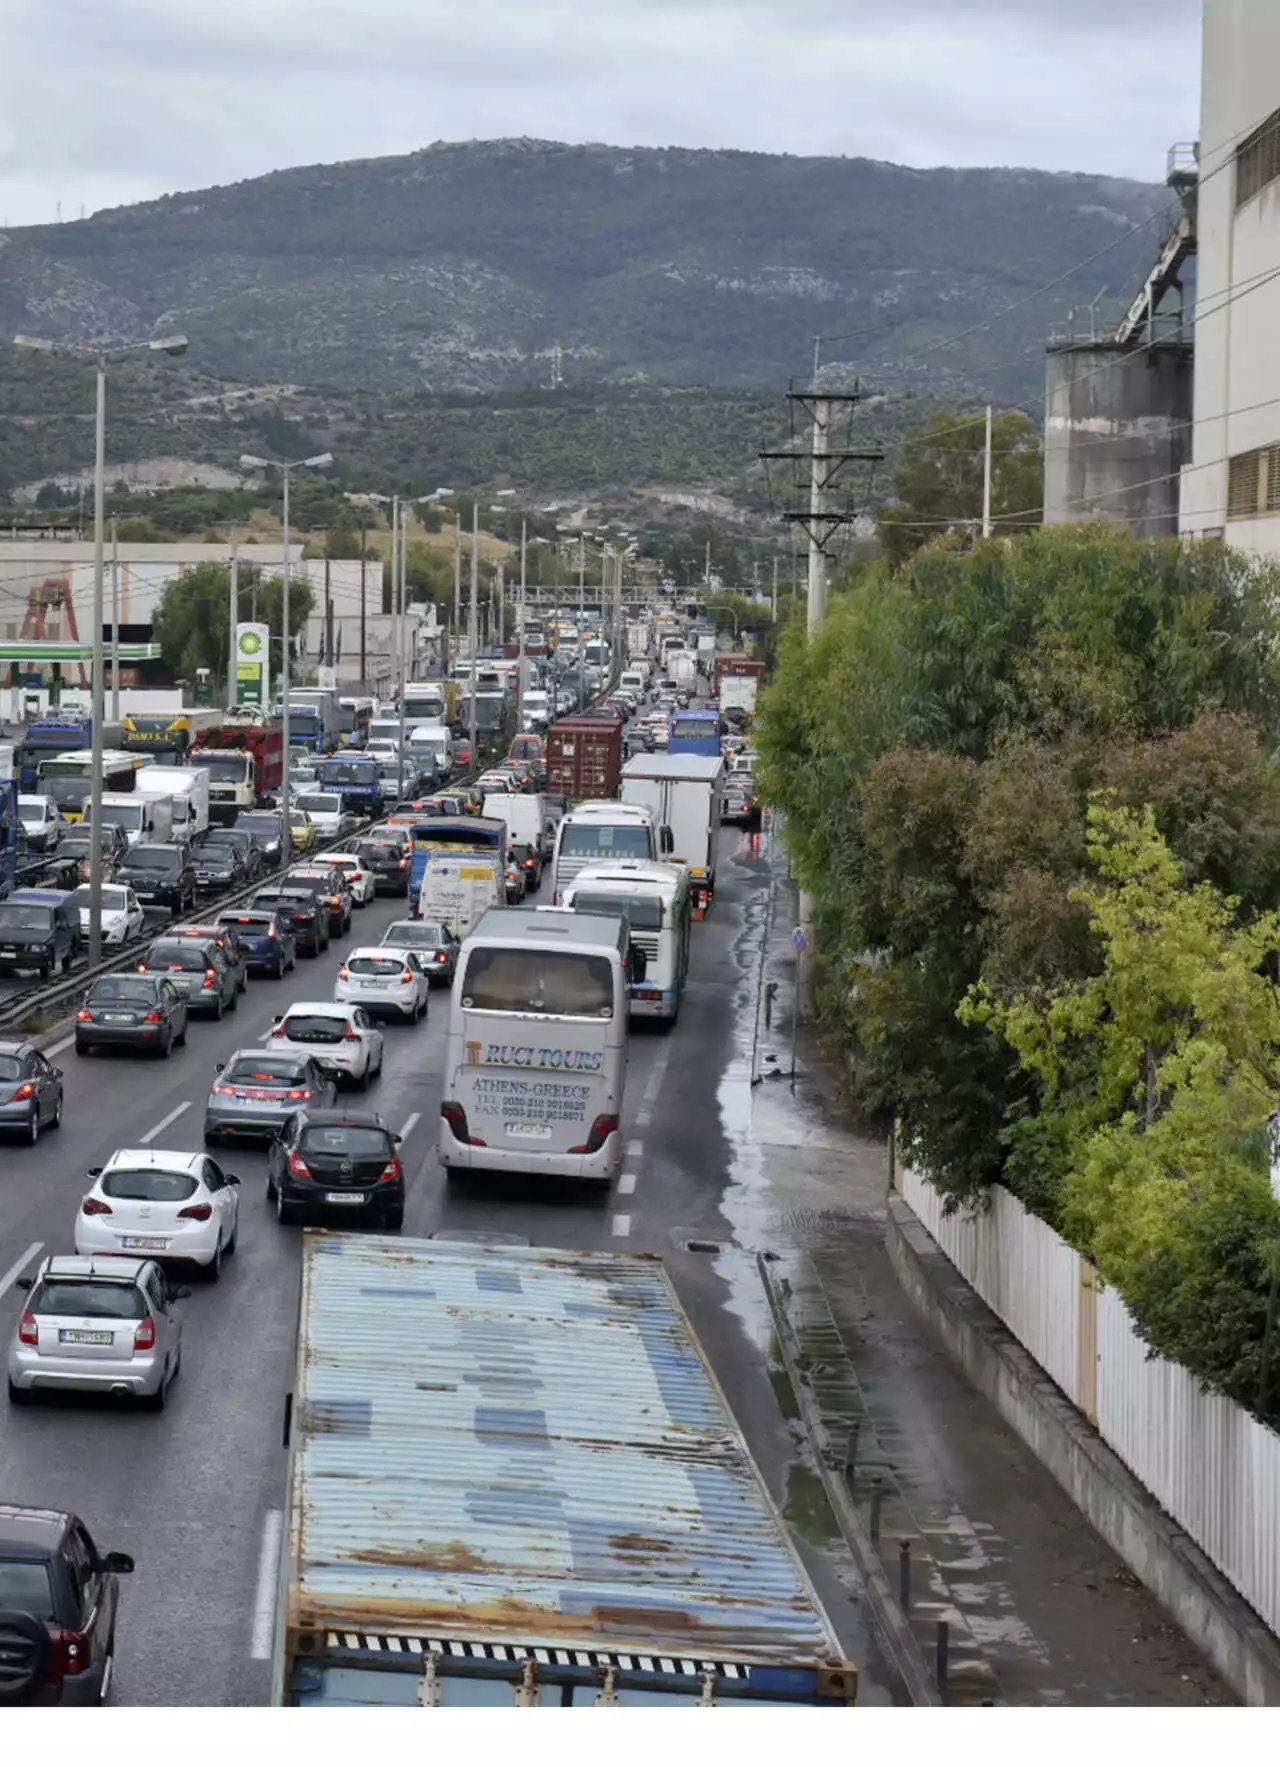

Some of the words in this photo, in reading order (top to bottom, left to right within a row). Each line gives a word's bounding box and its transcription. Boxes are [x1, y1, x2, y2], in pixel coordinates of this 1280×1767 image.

[485, 1044, 535, 1066] RUCI
[538, 1047, 603, 1071] TOURS
[472, 1077, 591, 1099] ATHENS-GREECE
